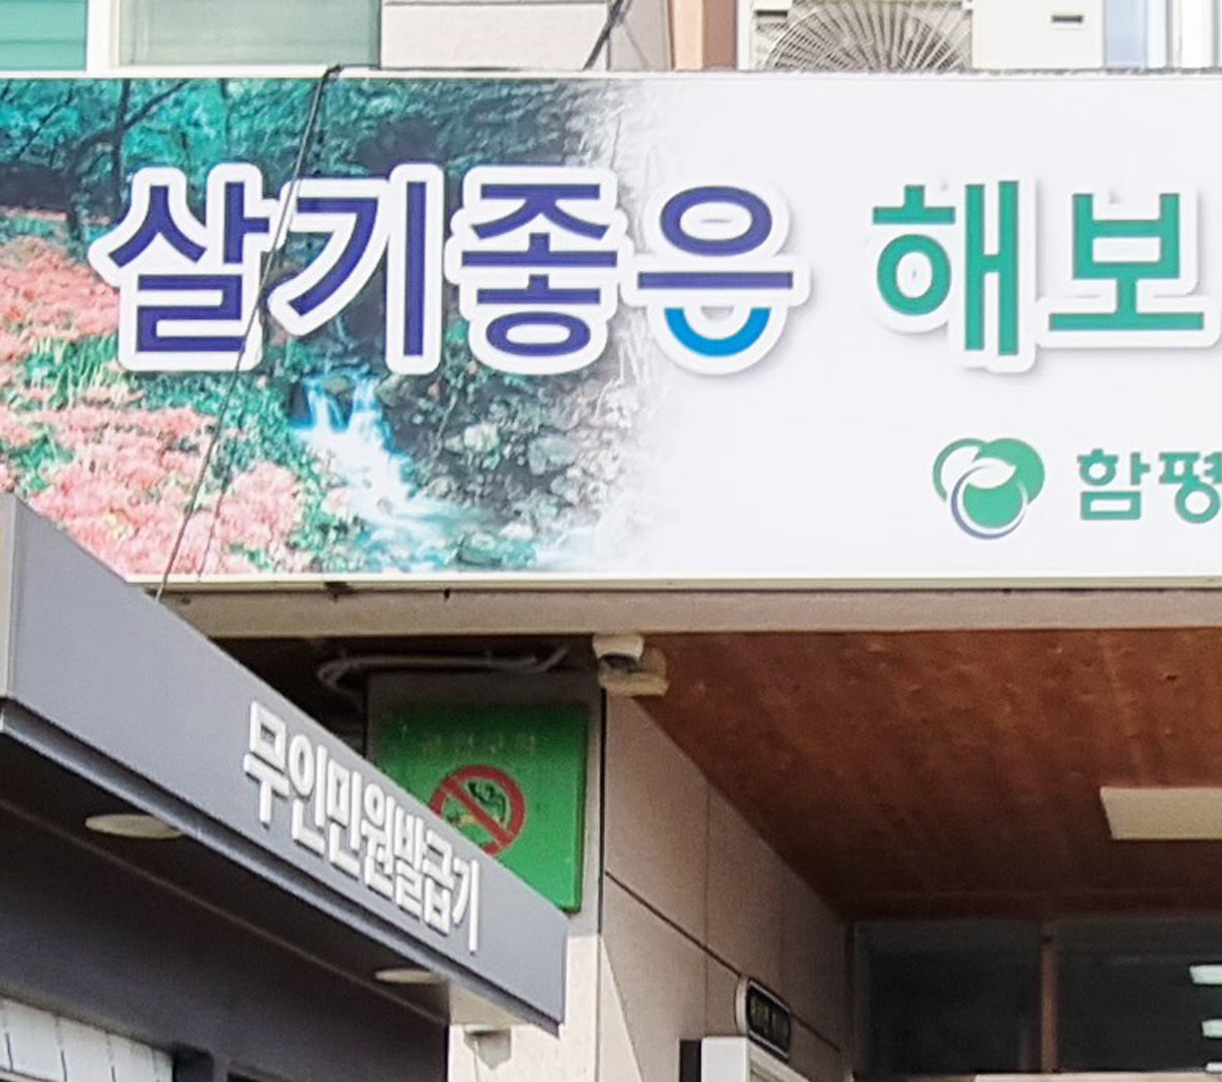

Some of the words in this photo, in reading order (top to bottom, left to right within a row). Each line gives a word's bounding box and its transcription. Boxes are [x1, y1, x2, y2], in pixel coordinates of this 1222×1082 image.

[107, 178, 795, 359] 살기좋은
[871, 178, 1206, 356] 해보
[242, 699, 482, 955] 무인민원발급기
